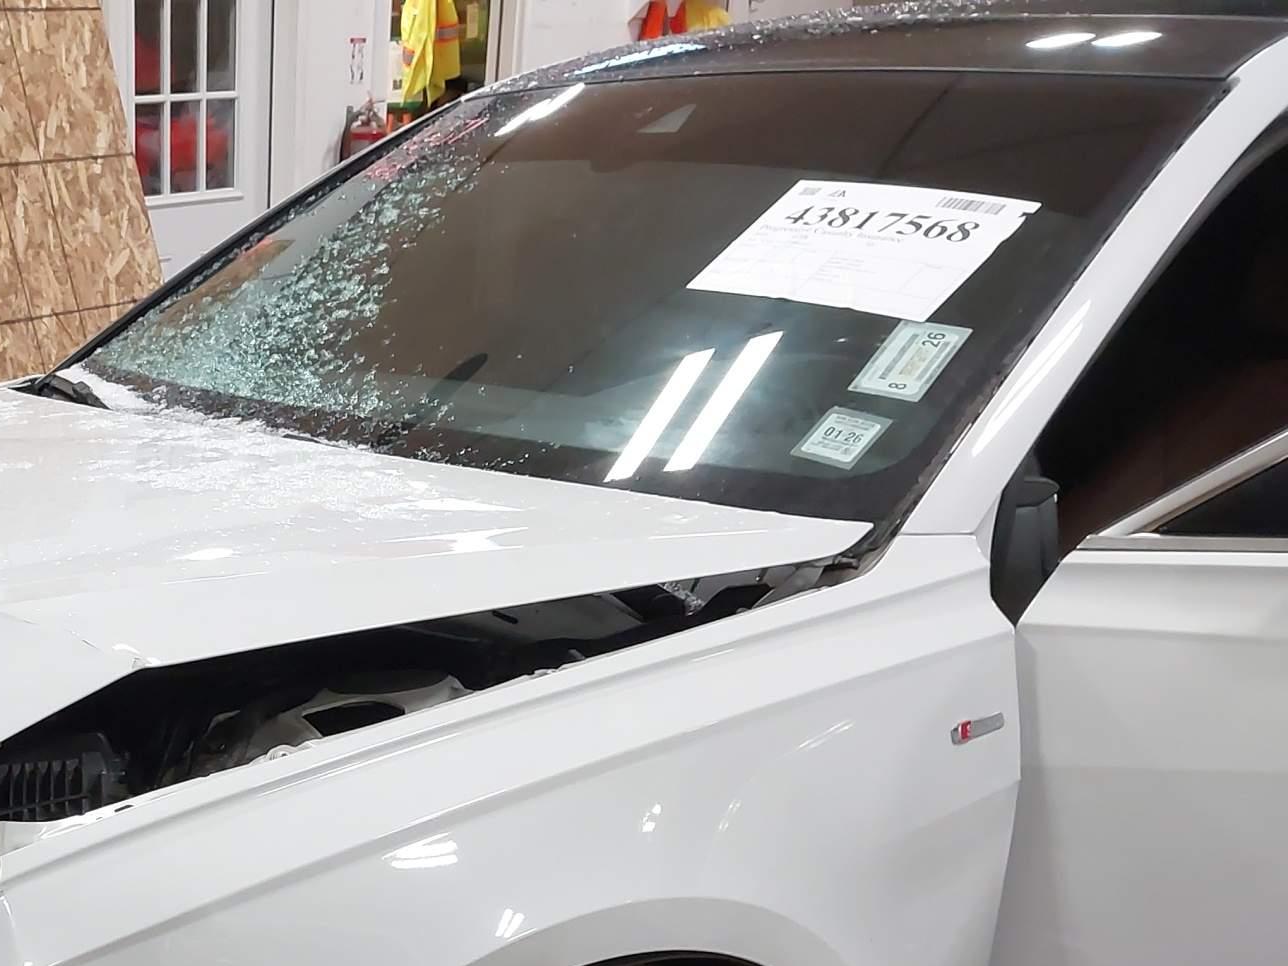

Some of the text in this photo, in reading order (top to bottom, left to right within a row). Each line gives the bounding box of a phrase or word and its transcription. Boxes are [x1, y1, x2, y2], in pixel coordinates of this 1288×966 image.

[785, 206, 980, 242] 43817568
[888, 382, 907, 390] 8
[922, 332, 946, 348] 26
[823, 426, 864, 443] 01 26
